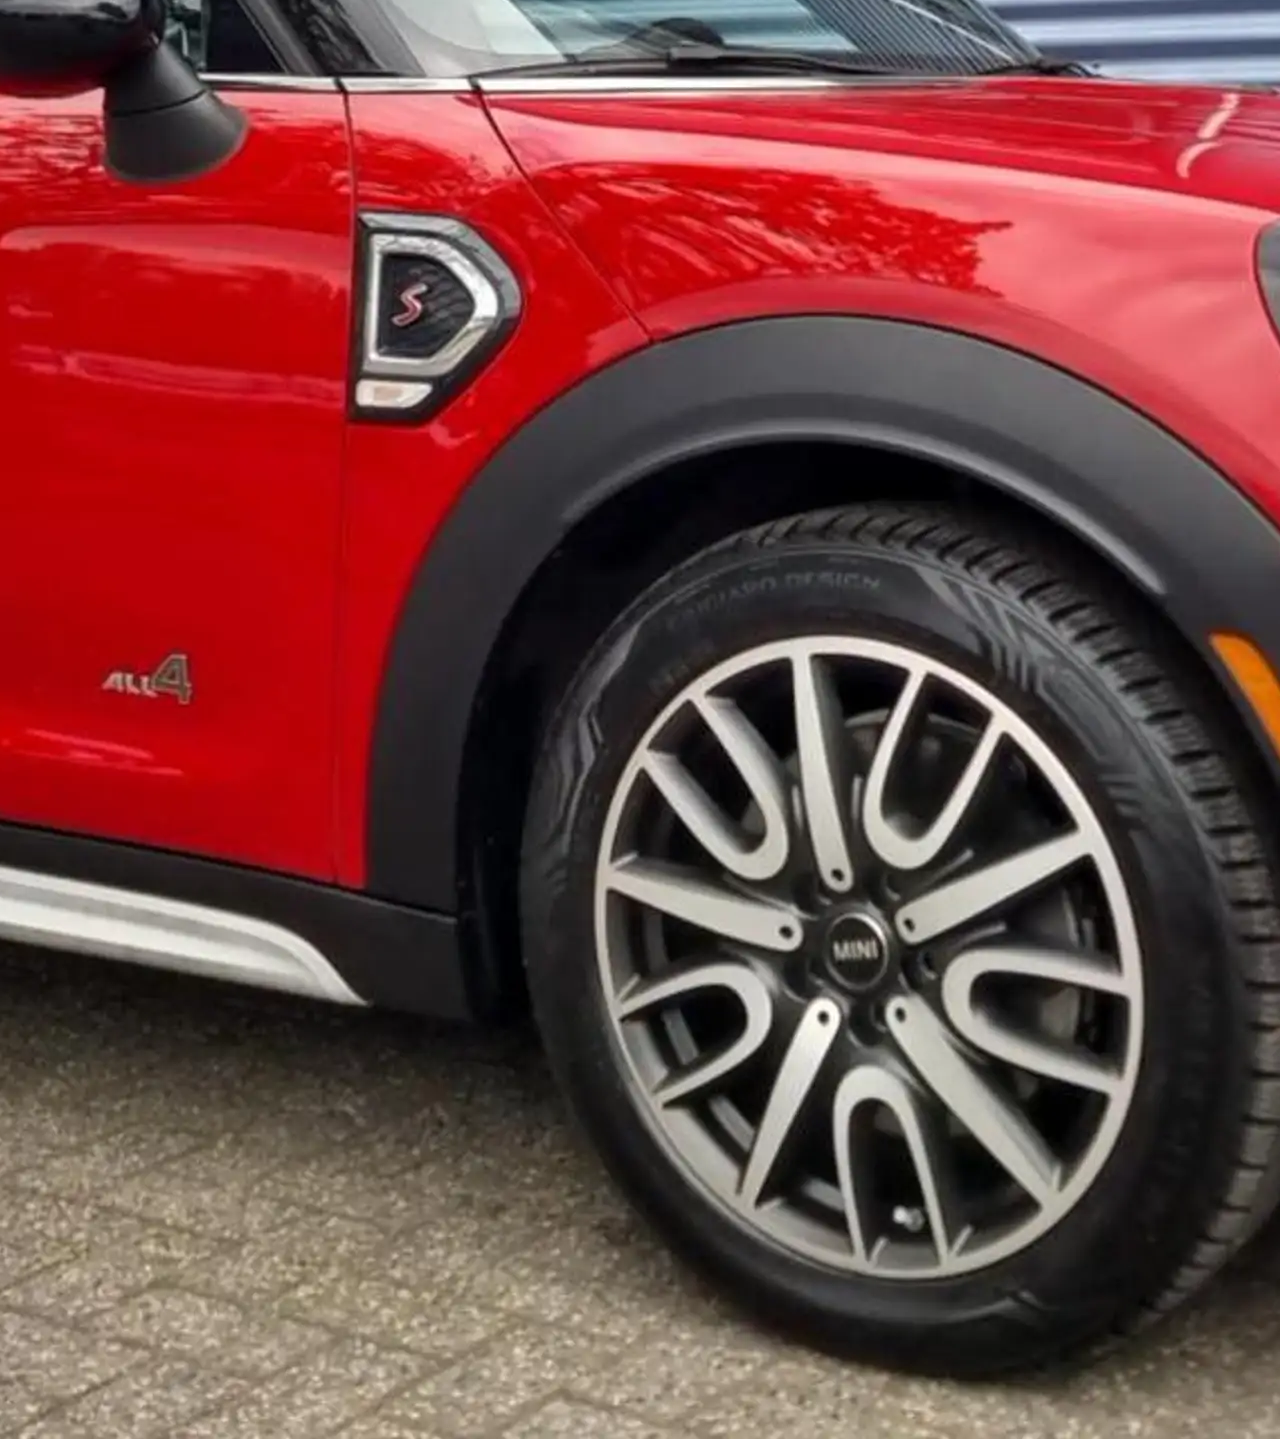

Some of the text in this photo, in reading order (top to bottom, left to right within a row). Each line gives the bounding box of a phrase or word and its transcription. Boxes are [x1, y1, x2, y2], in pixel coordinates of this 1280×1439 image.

[391, 282, 428, 328] S
[102, 653, 193, 705] ALL4
[832, 937, 879, 962] MINI
